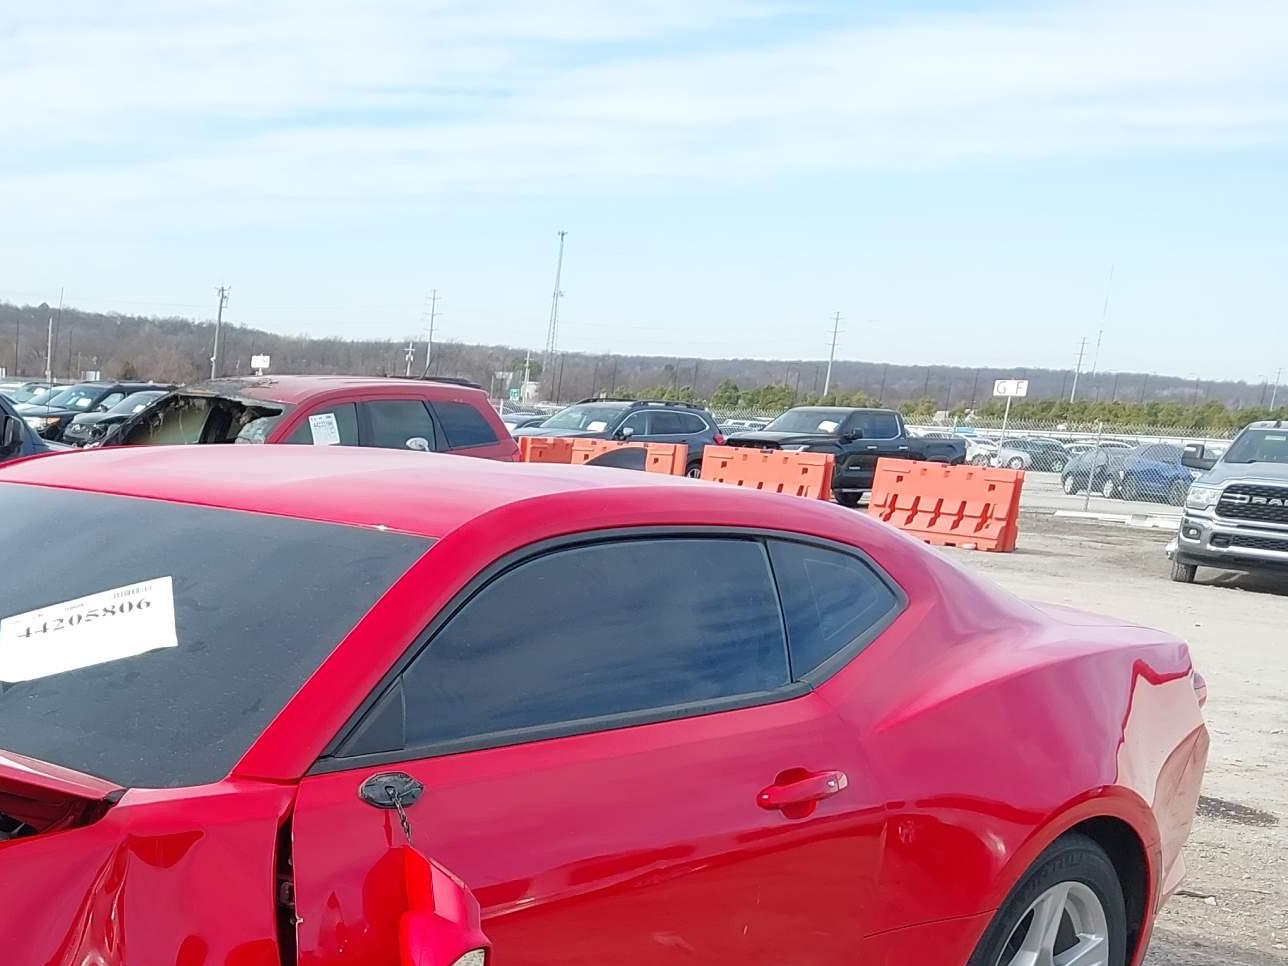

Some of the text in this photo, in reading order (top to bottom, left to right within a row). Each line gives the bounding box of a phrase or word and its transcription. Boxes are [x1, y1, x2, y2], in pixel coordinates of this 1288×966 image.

[997, 380, 1025, 395] G F
[1251, 496, 1288, 507] RA
[17, 598, 152, 638] 44205806
